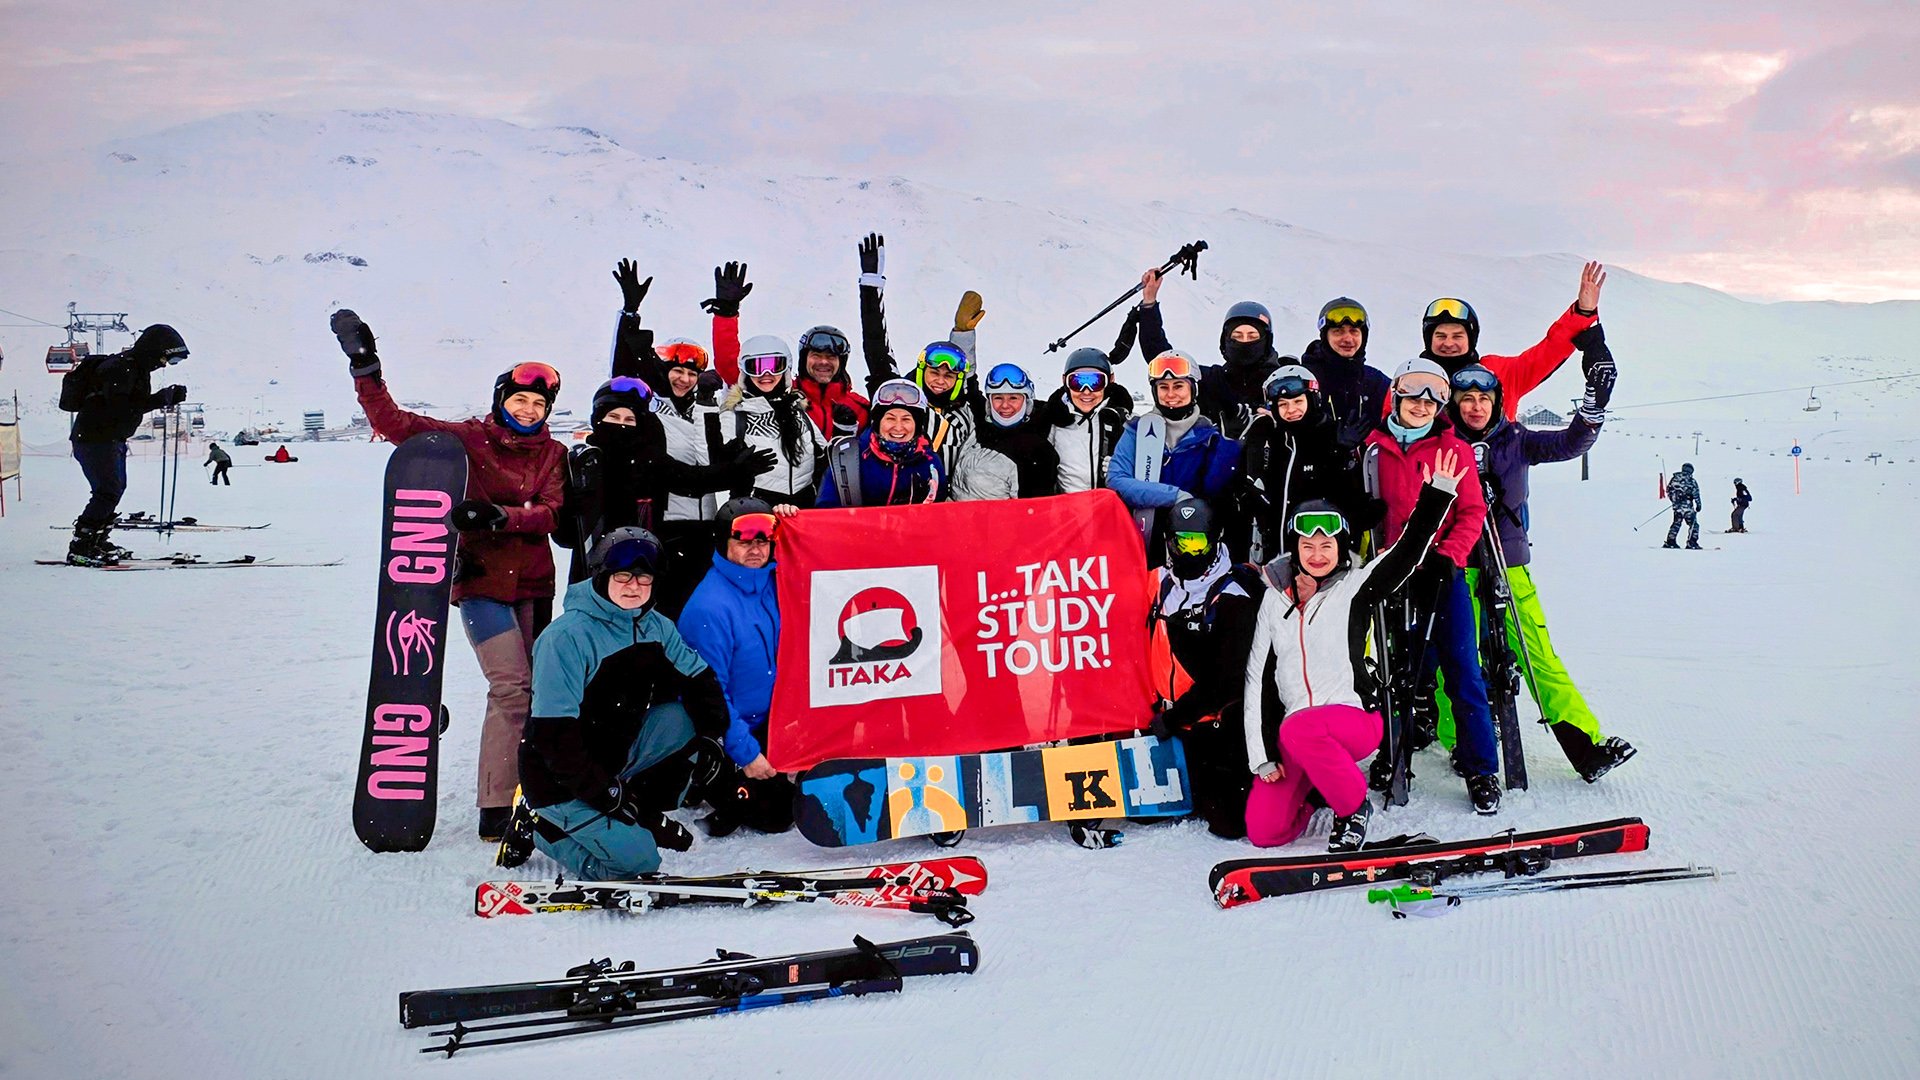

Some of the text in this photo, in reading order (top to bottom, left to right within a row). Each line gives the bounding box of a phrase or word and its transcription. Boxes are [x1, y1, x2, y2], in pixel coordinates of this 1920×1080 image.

[1144, 455, 1152, 482] ATOMIC
[387, 488, 452, 584] GNU
[976, 555, 1111, 604] I...TAKI
[976, 593, 1116, 640] STUDY
[828, 661, 912, 688] ITAKA
[976, 633, 1112, 679] TOUR!
[367, 702, 432, 801] GNU
[503, 881, 523, 897] 159
